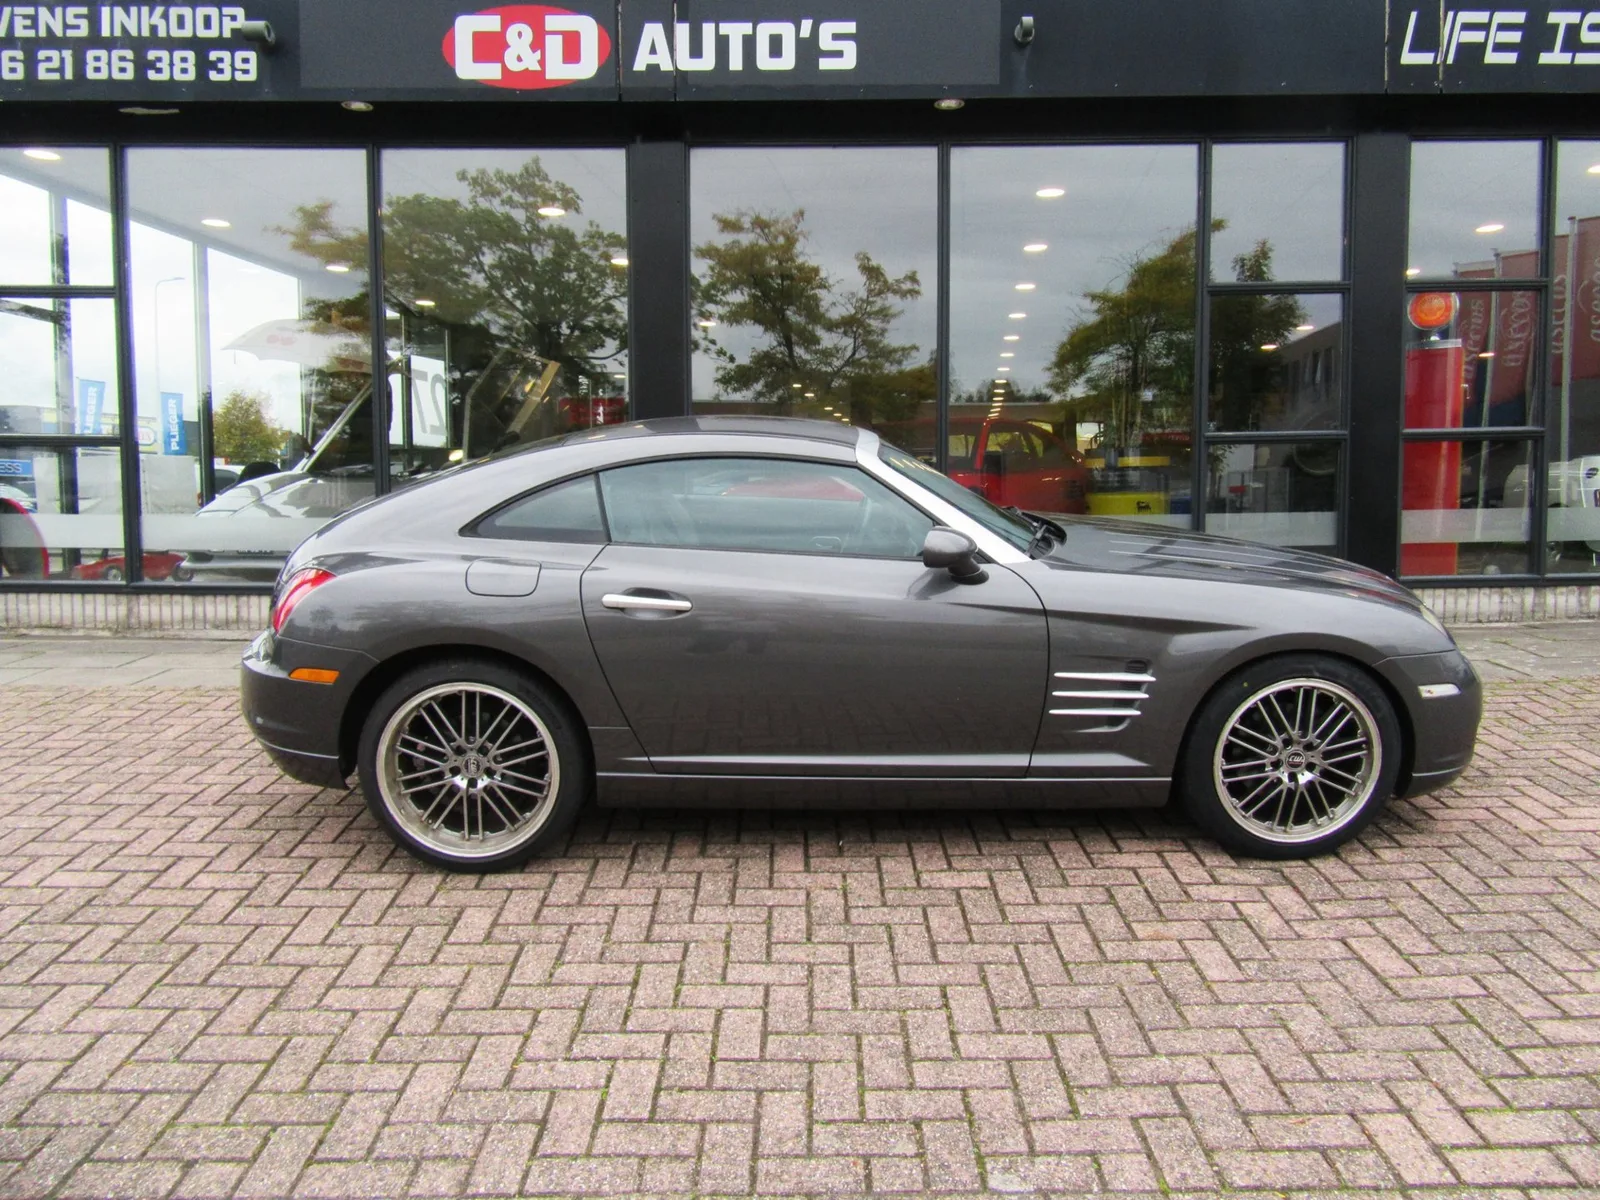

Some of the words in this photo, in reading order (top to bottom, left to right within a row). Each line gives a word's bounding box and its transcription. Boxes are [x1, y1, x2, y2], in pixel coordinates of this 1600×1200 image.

[101, 6, 245, 38] INKOOP
[454, 14, 599, 79] C&D
[633, 19, 858, 71] AUTO'S
[1400, 11, 1527, 64] LIFE
[1538, 11, 1600, 65] IS
[1, 49, 25, 80] 6
[37, 49, 74, 80] 21
[86, 49, 135, 80] 86
[147, 50, 196, 81] 38
[208, 50, 257, 81] 39
[84, 386, 98, 434] LIEGER
[167, 398, 180, 450] PLIEGER
